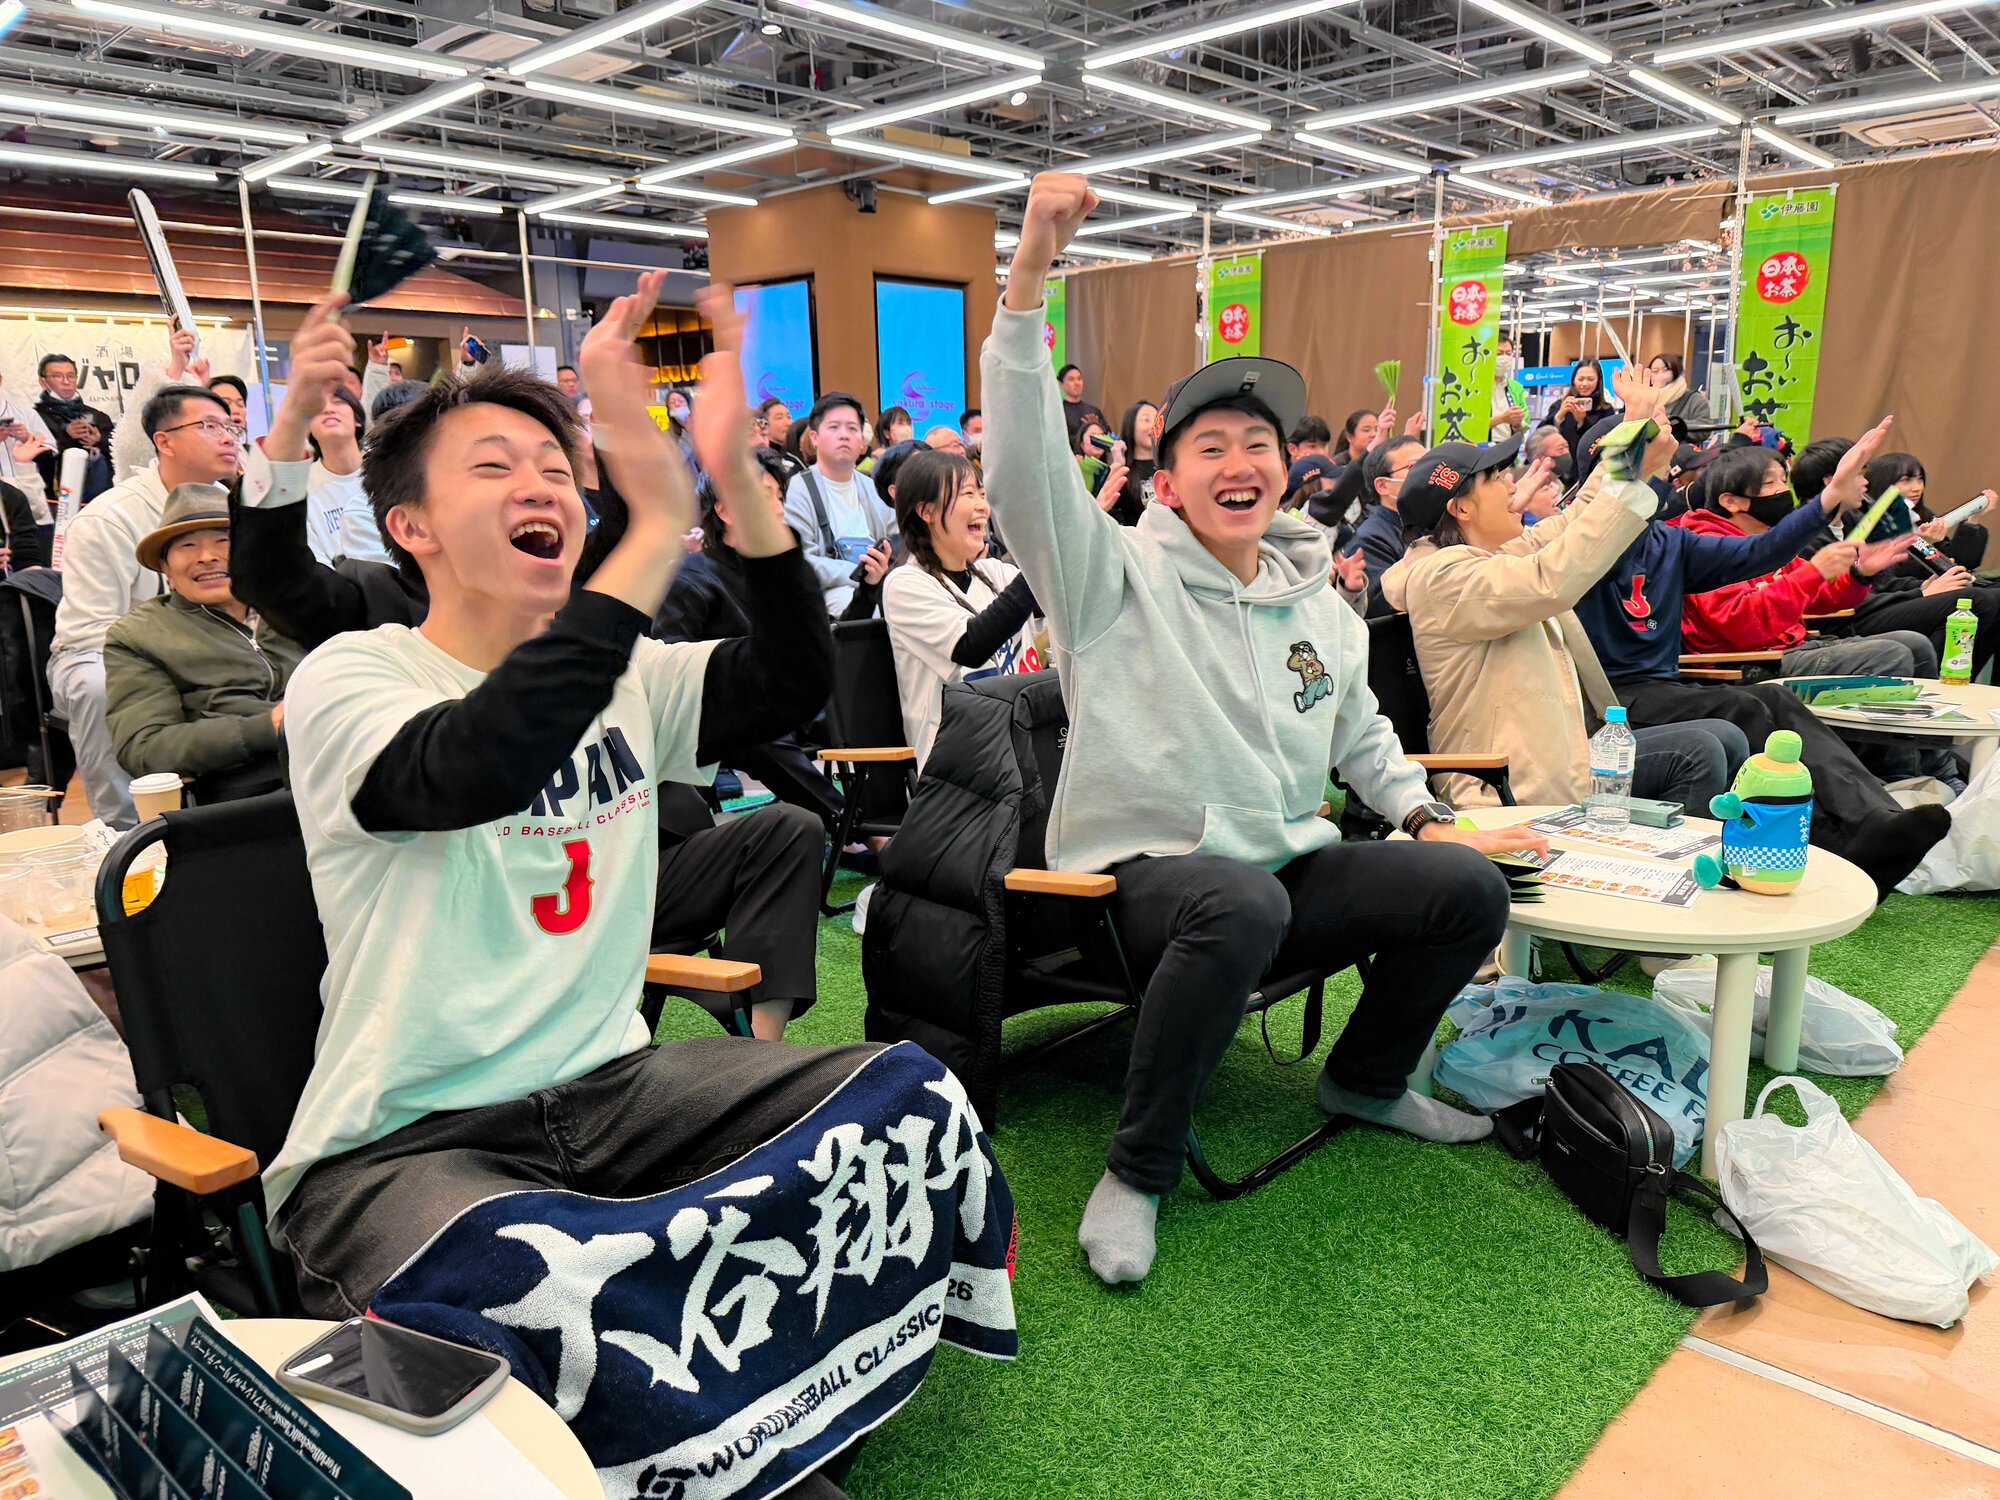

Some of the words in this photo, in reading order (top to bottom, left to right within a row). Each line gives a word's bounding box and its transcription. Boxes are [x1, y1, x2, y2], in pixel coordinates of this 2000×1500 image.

[1780, 201, 1818, 214] 伊藤園
[1763, 277, 1798, 298] お茶
[929, 400, 955, 412] stage
[1434, 467, 1460, 491] 16
[1621, 574, 1652, 619] J
[507, 726, 645, 817] PAN
[520, 820, 591, 837] BASEBLL
[596, 788, 650, 825] CLASSIC
[530, 837, 596, 936] J
[854, 1303, 942, 1376] CLASSIC
